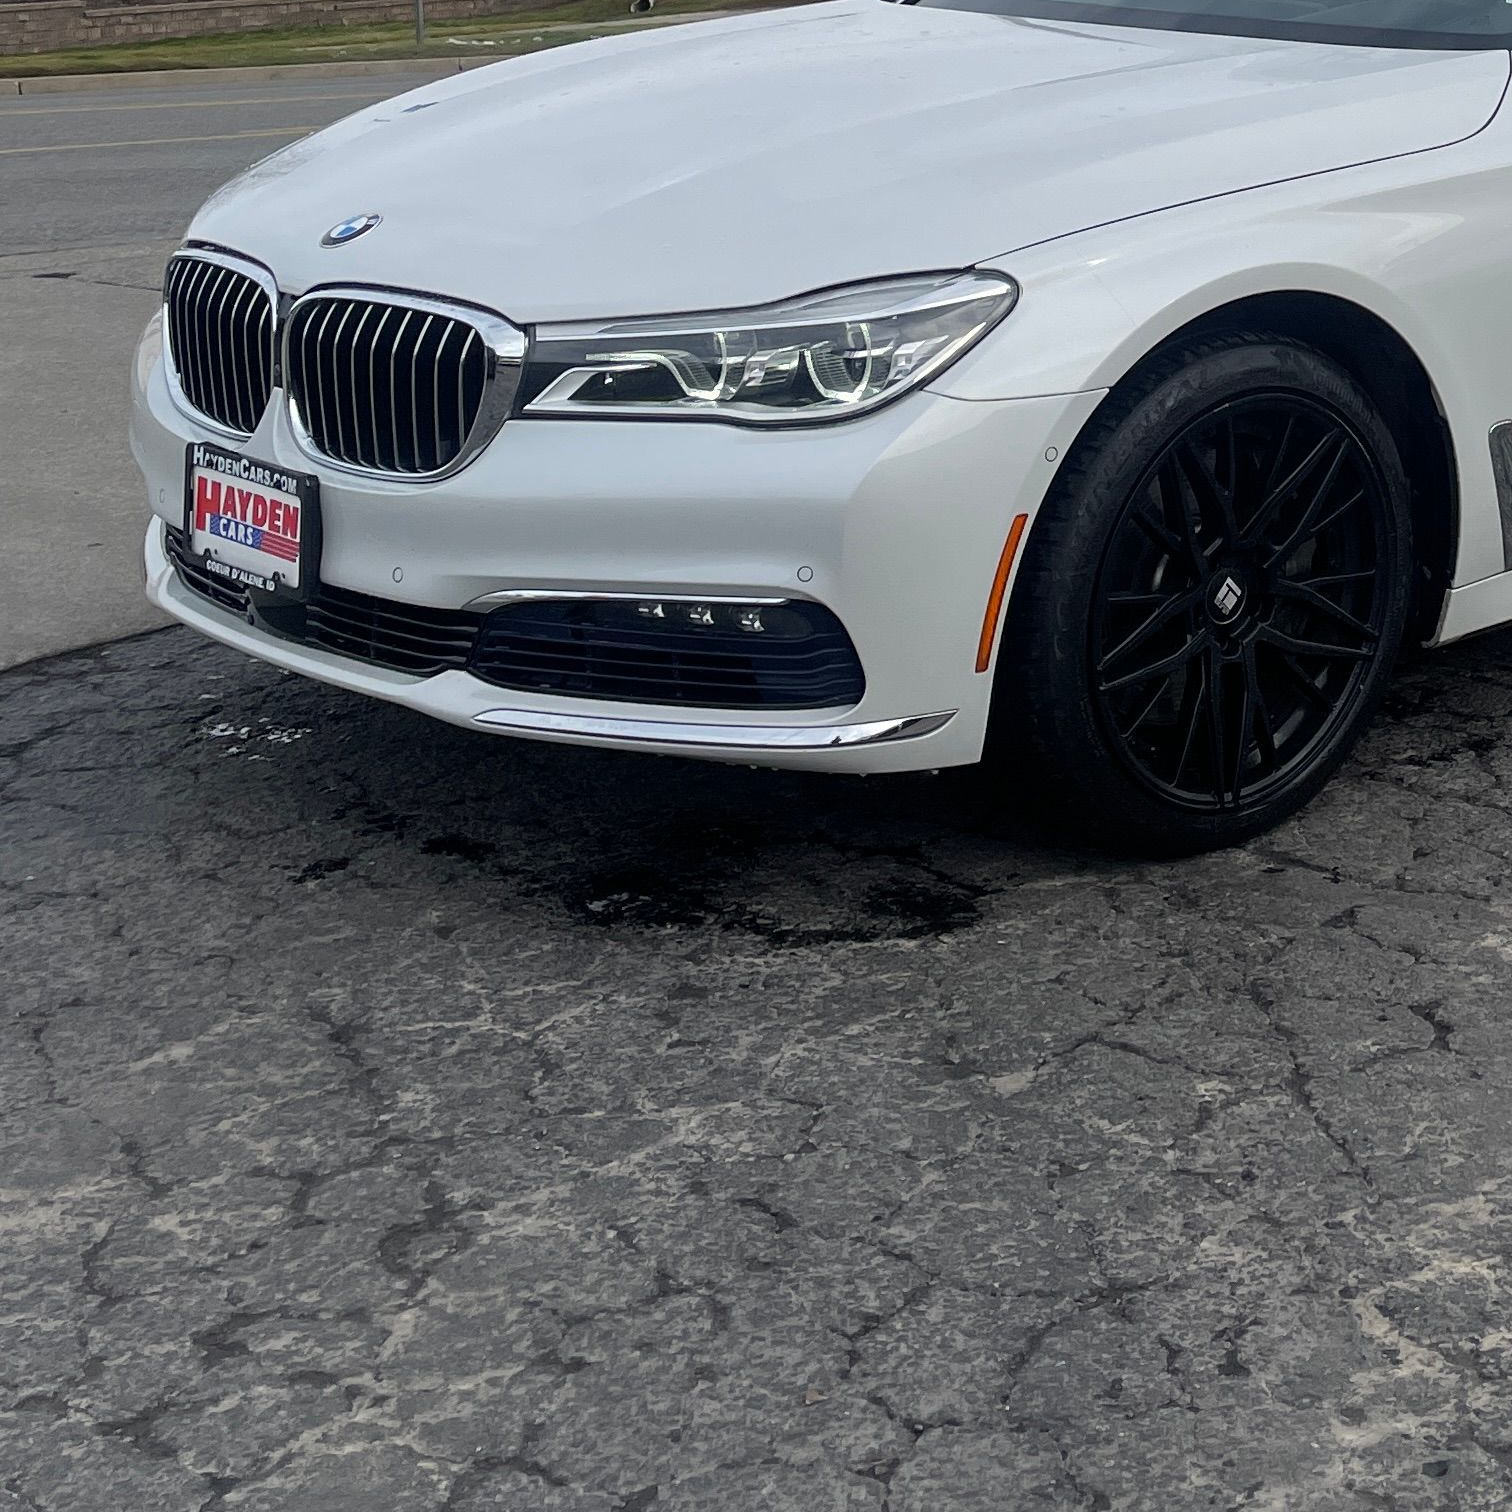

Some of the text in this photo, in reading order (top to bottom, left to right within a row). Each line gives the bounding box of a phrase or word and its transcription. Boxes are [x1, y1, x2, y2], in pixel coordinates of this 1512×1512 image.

[196, 476, 299, 539] HAYDEN
[219, 518, 253, 545] CARS
[206, 560, 231, 576] COEUR
